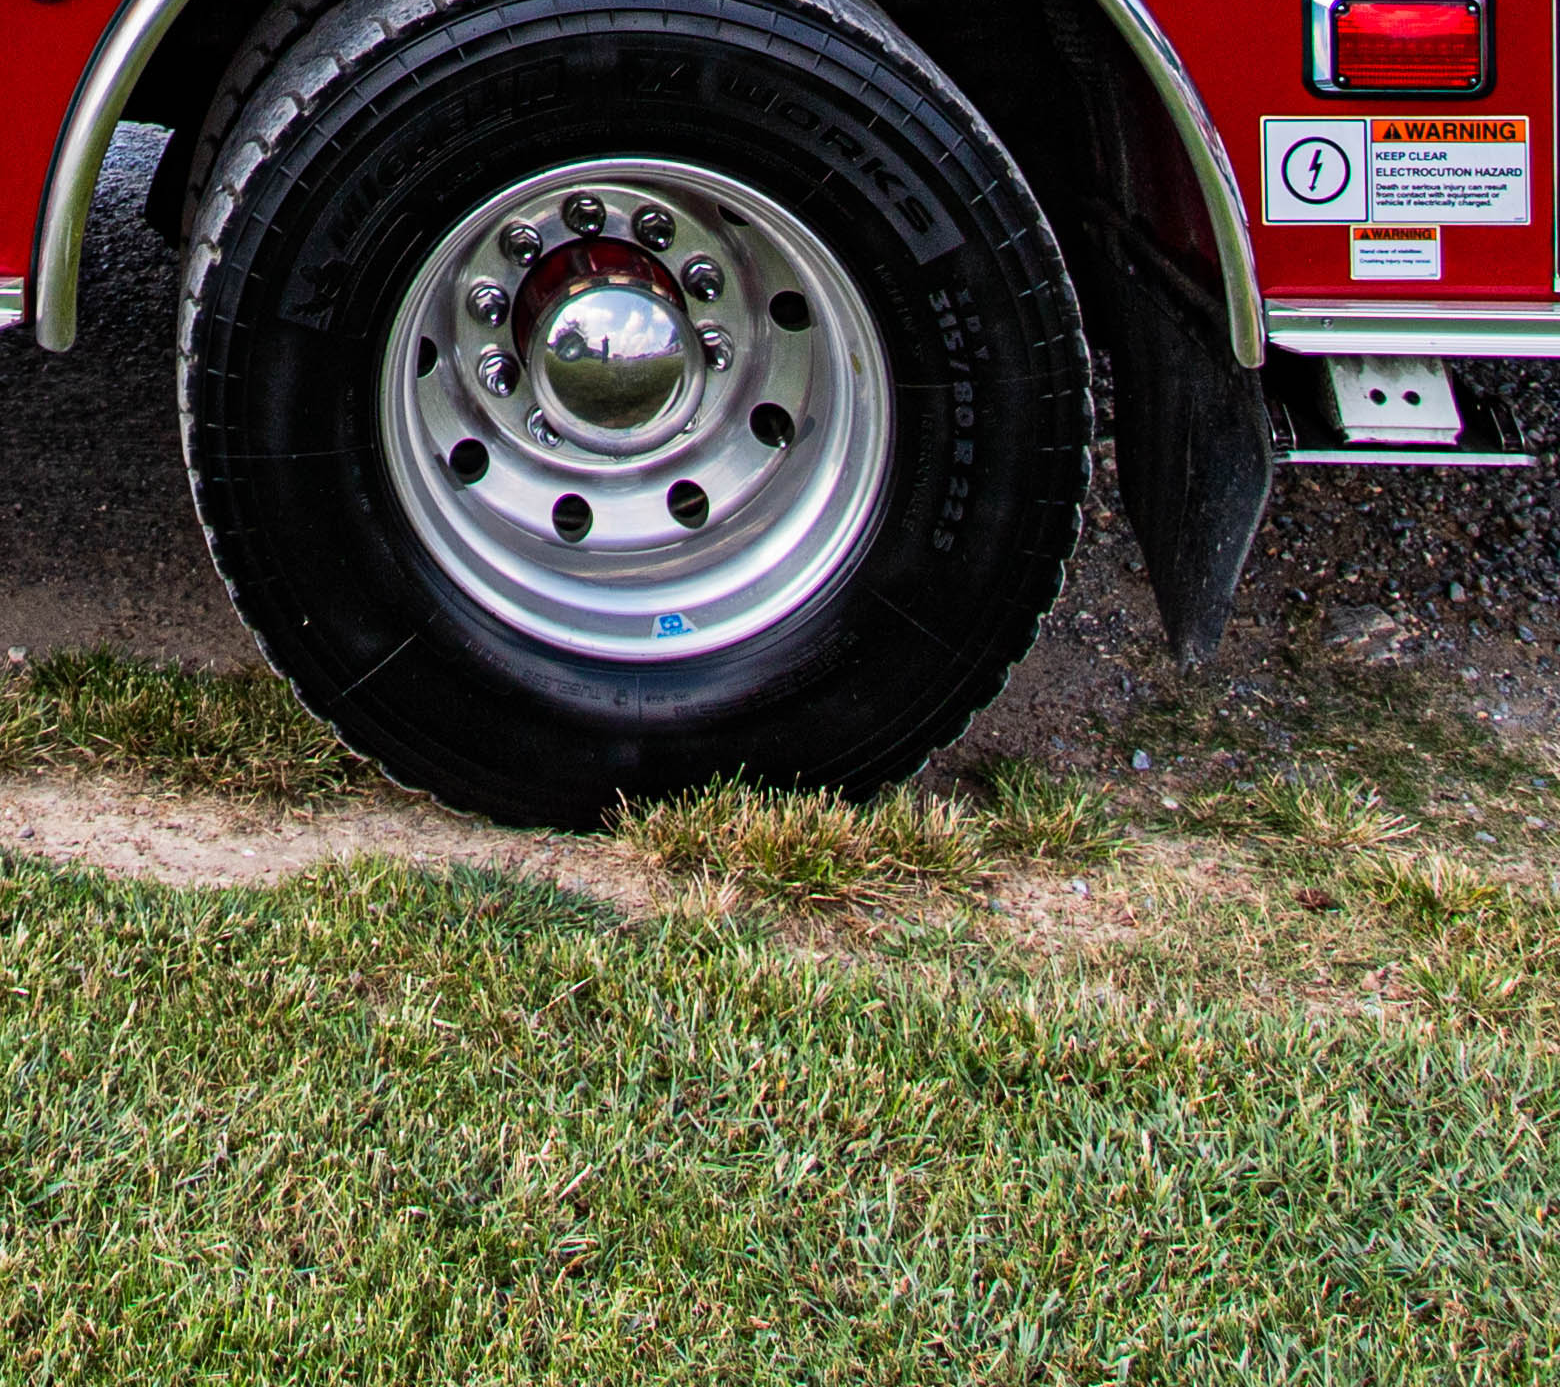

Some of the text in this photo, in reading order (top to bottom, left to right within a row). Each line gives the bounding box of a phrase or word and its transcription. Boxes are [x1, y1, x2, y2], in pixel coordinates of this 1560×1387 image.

[1405, 122, 1516, 140] WARNING
[720, 72, 938, 235] WORKS
[1375, 152, 1447, 161] KEEP CLEAR
[1375, 168, 1523, 177] ELECTROCUTION HAZARD
[1443, 184, 1465, 192] injury
[1447, 192, 1489, 200] equipment
[1413, 200, 1456, 208] electrically
[1373, 228, 1431, 240] WARNING
